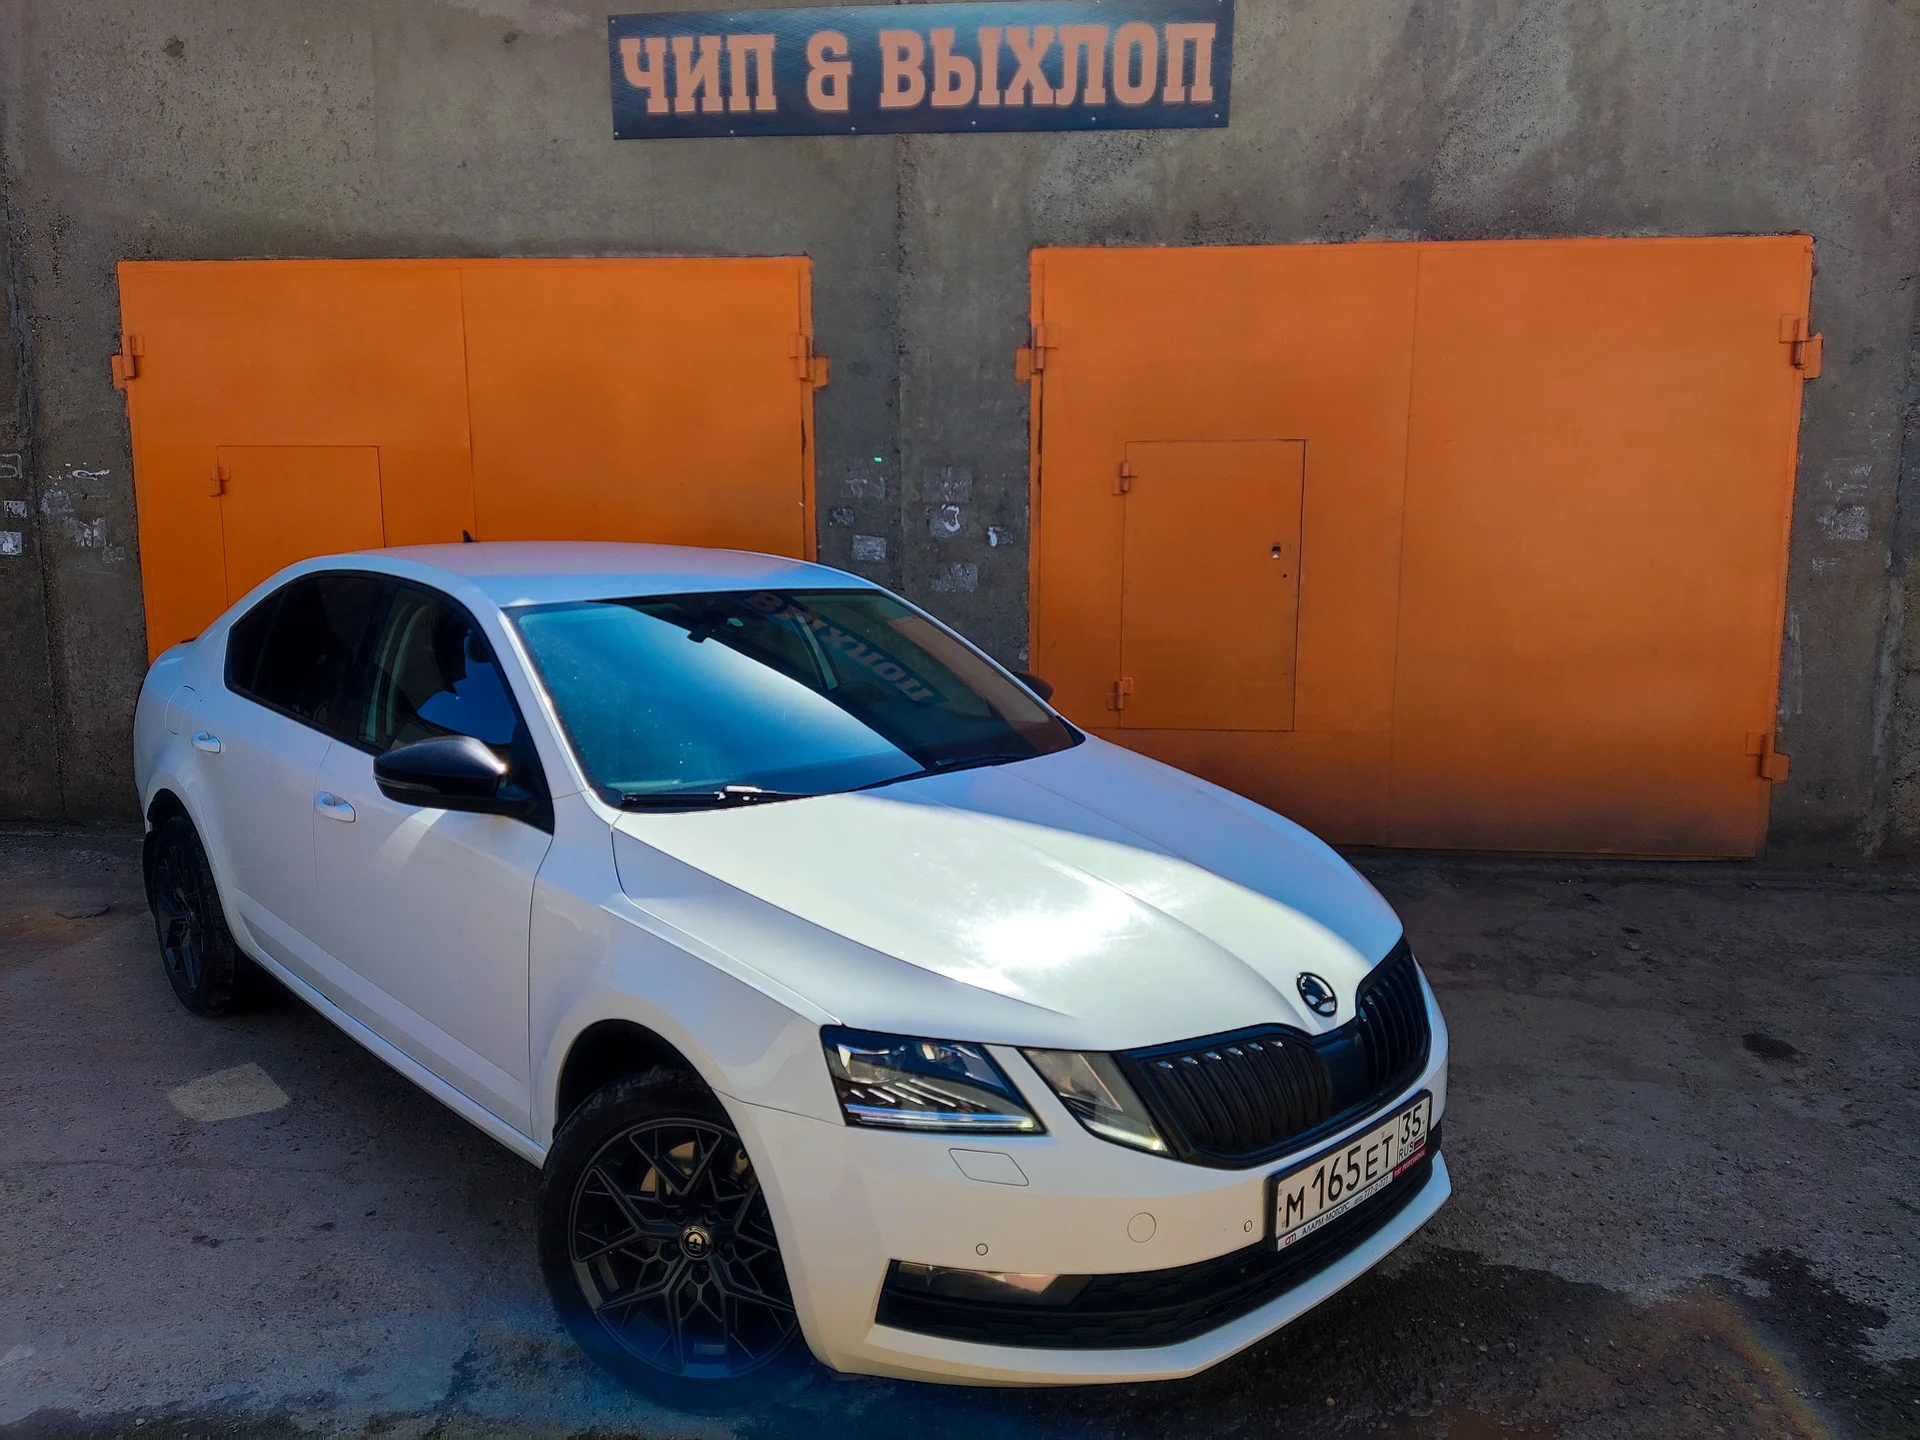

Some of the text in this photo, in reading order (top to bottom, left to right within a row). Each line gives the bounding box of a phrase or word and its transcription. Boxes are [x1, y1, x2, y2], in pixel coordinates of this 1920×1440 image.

[621, 22, 1217, 112] ЧИП & ВЫХЛОП
[1401, 1104, 1423, 1143] 35
[1399, 1143, 1415, 1160] RUS
